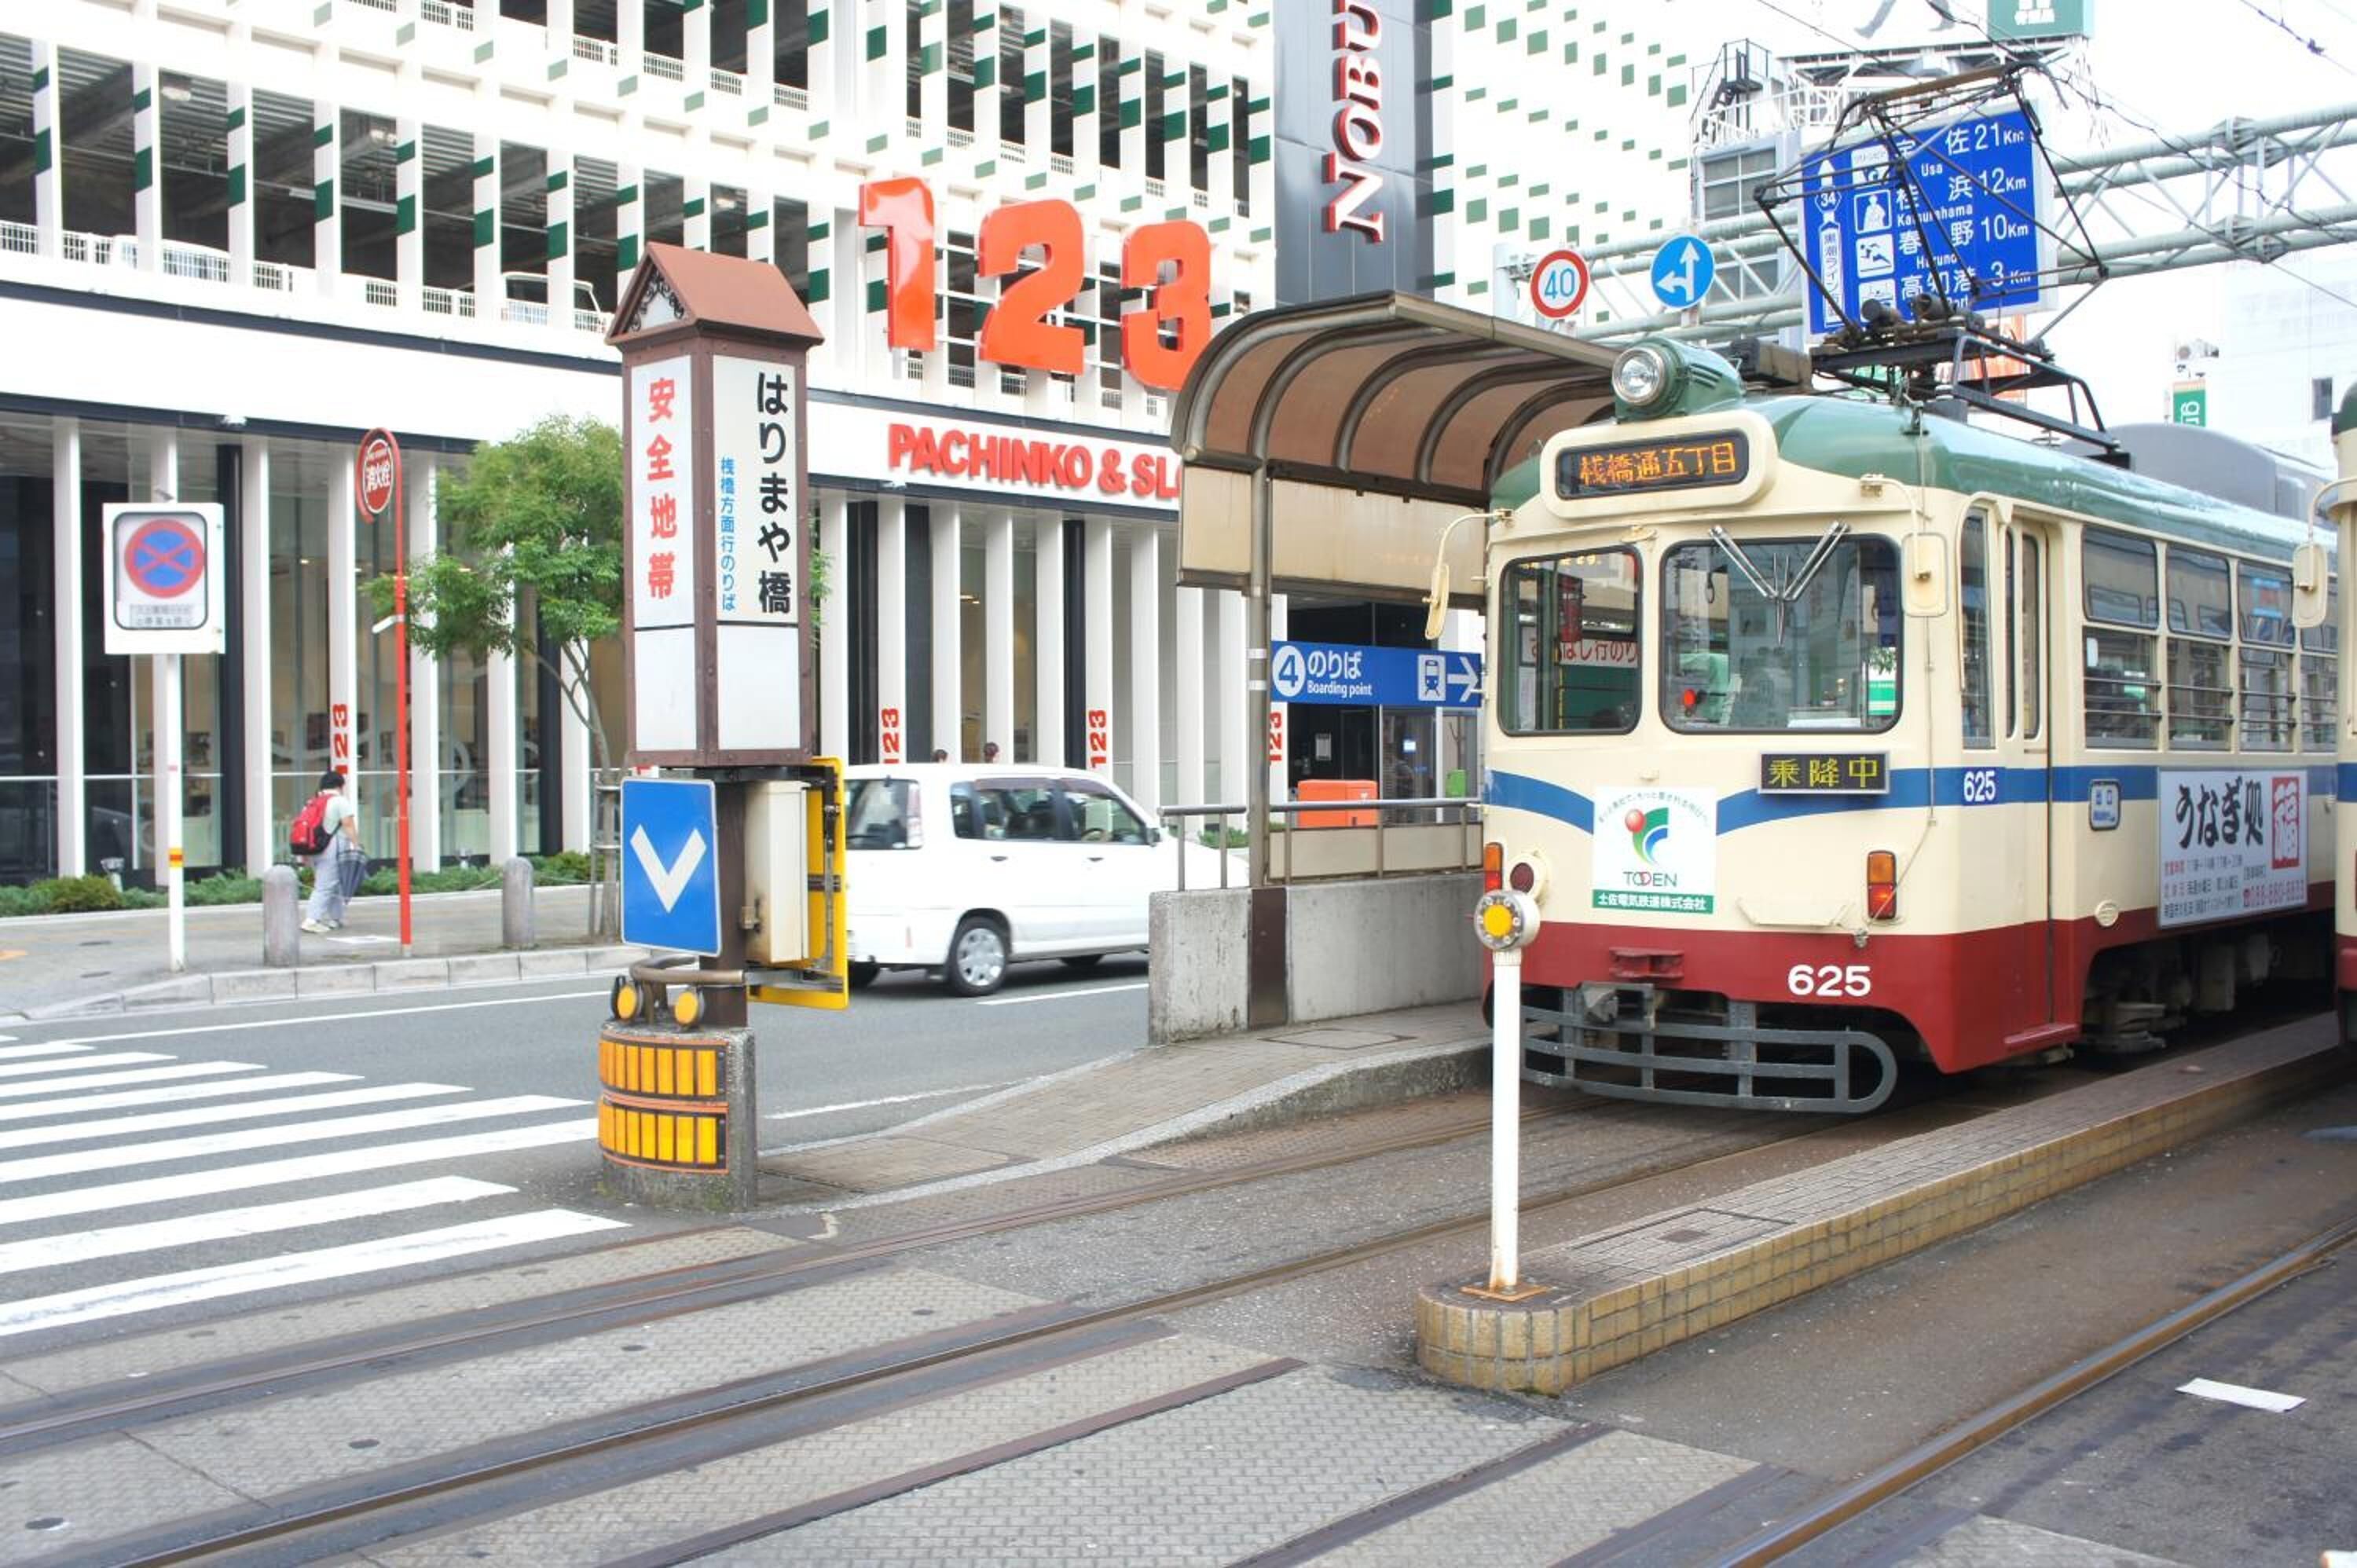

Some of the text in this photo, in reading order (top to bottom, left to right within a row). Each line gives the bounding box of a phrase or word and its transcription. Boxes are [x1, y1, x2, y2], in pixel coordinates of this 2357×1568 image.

[1921, 163, 1944, 177] Usa
[1820, 192, 1836, 207] 34
[1899, 219, 1974, 255] 春野
[859, 177, 1211, 390] 123
[1544, 268, 1575, 299] 40
[365, 461, 390, 492] 消火栓
[889, 423, 1182, 499] PACHINKO & SL
[647, 378, 677, 599] 安全地帯
[757, 372, 790, 614] はりまや橋
[720, 456, 735, 611] 桟橋方面行のりば
[1307, 650, 1363, 680] のりば
[1307, 680, 1373, 698] Boarding point
[1089, 710, 1107, 768] 123
[1769, 757, 1879, 788] 乗降中
[1964, 771, 1996, 802] 625
[2176, 775, 2264, 850] うなぎ処
[1622, 870, 1677, 887] TODEN
[1788, 964, 1871, 997] 625
